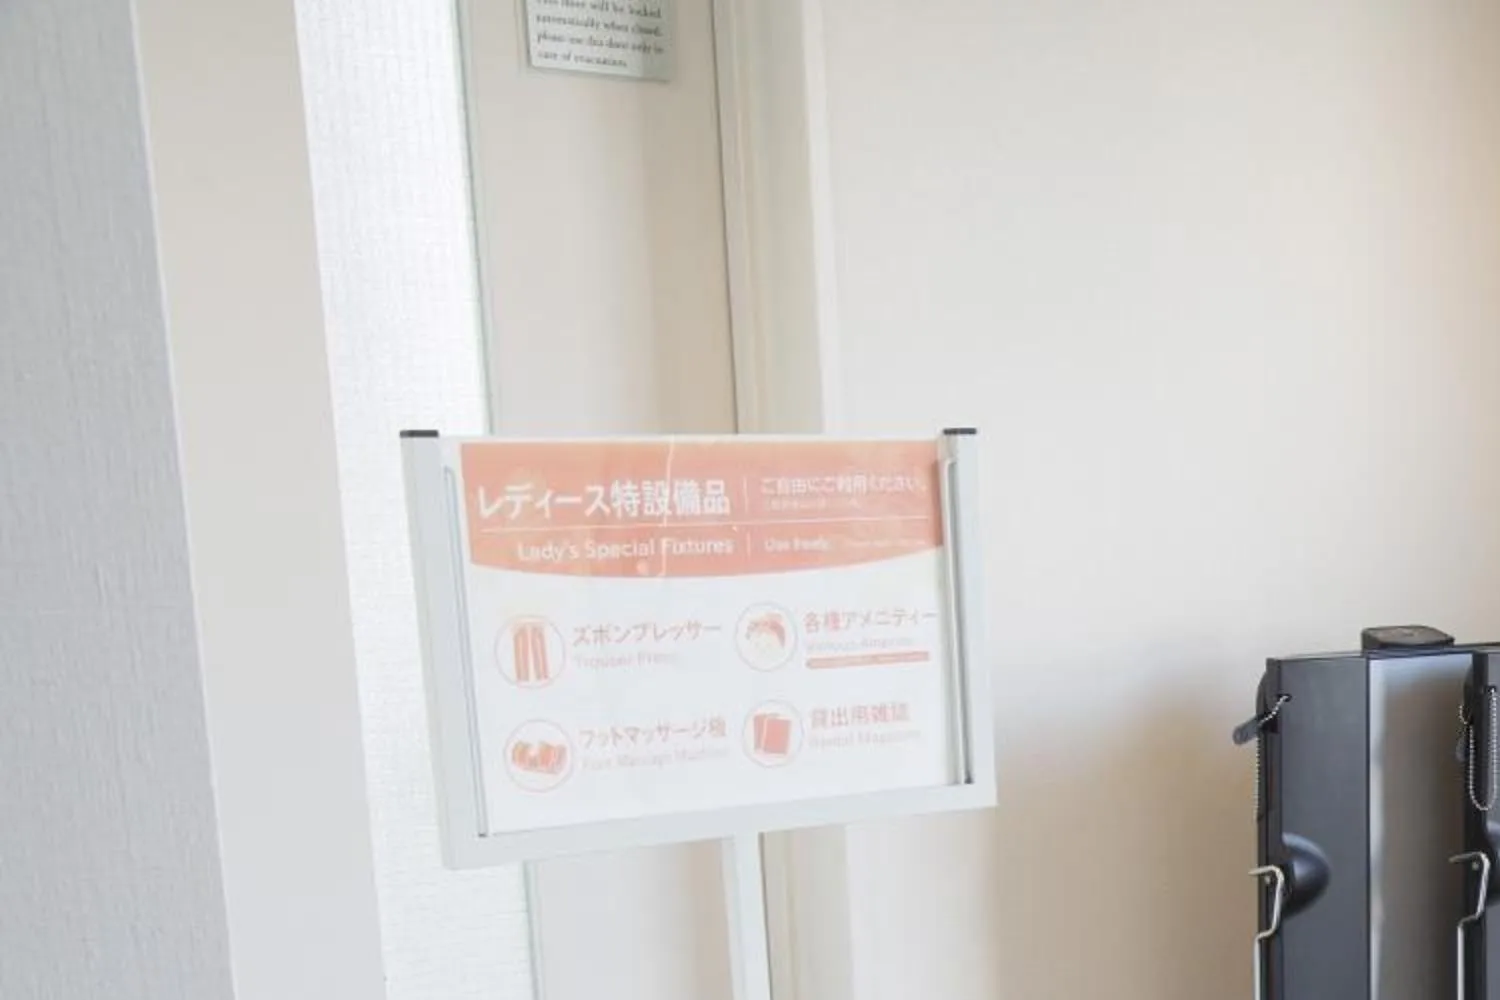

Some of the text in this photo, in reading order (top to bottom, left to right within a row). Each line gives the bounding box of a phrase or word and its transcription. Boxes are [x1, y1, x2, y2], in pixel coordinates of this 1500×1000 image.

[478, 479, 731, 519] レディース特設備品
[517, 539, 580, 562] Lady's
[585, 537, 656, 560] Special
[573, 620, 721, 647] ズボンプレッサー
[805, 608, 938, 634] 各種アメニティー
[579, 717, 727, 747] フットマッサージ機
